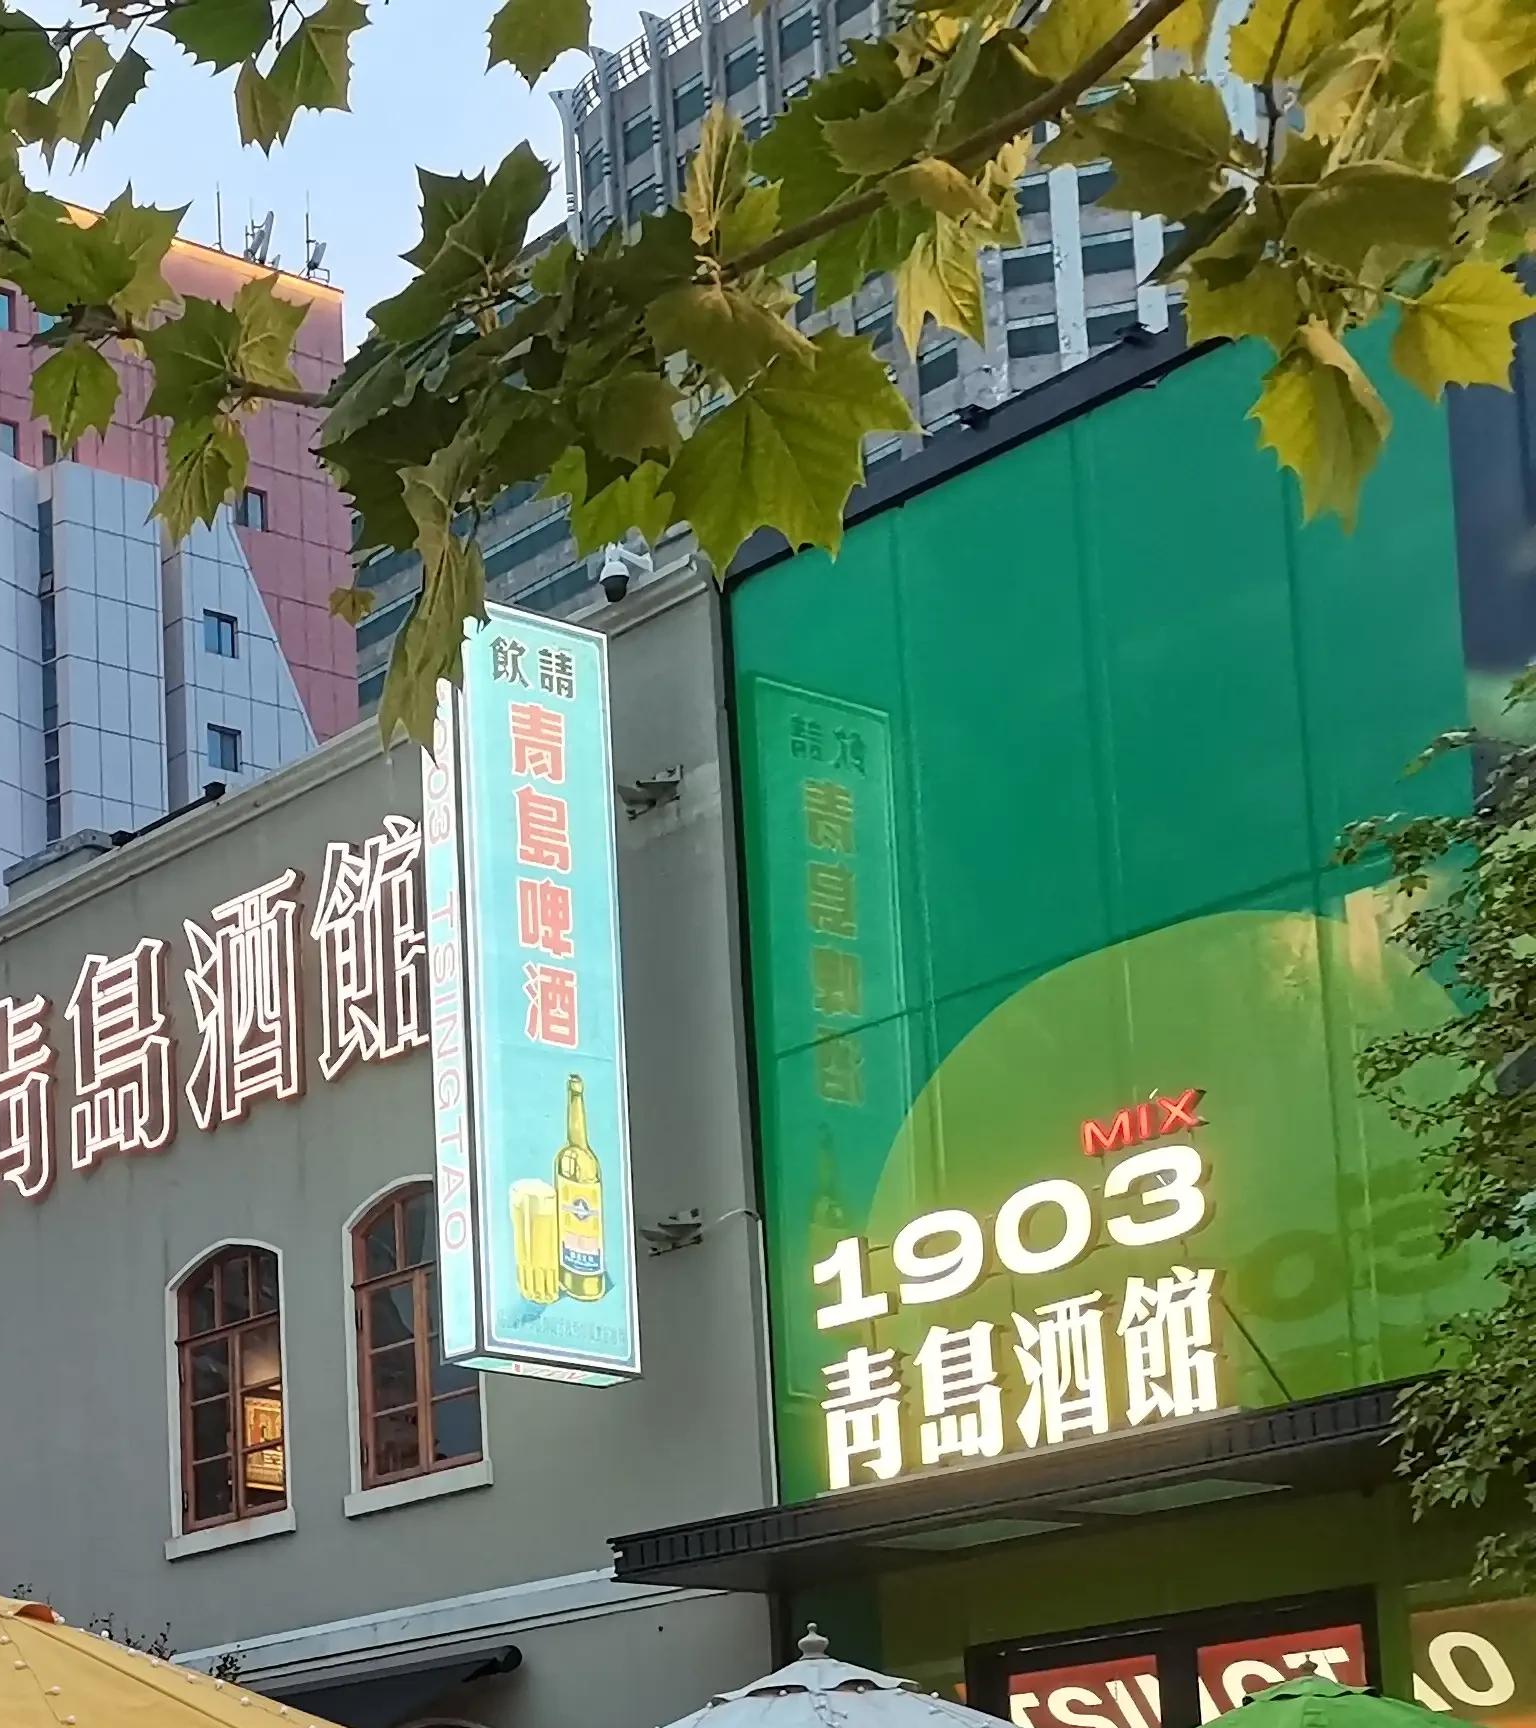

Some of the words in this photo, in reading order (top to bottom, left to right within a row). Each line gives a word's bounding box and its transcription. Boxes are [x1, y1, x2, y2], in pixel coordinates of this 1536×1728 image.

[509, 701, 579, 1050] 青島啤酒
[431, 888, 467, 1251] TSINGTAO
[1080, 1088, 1208, 1157] MIX
[812, 1143, 1212, 1333] 1903
[820, 1264, 1221, 1492] 青島酒館
